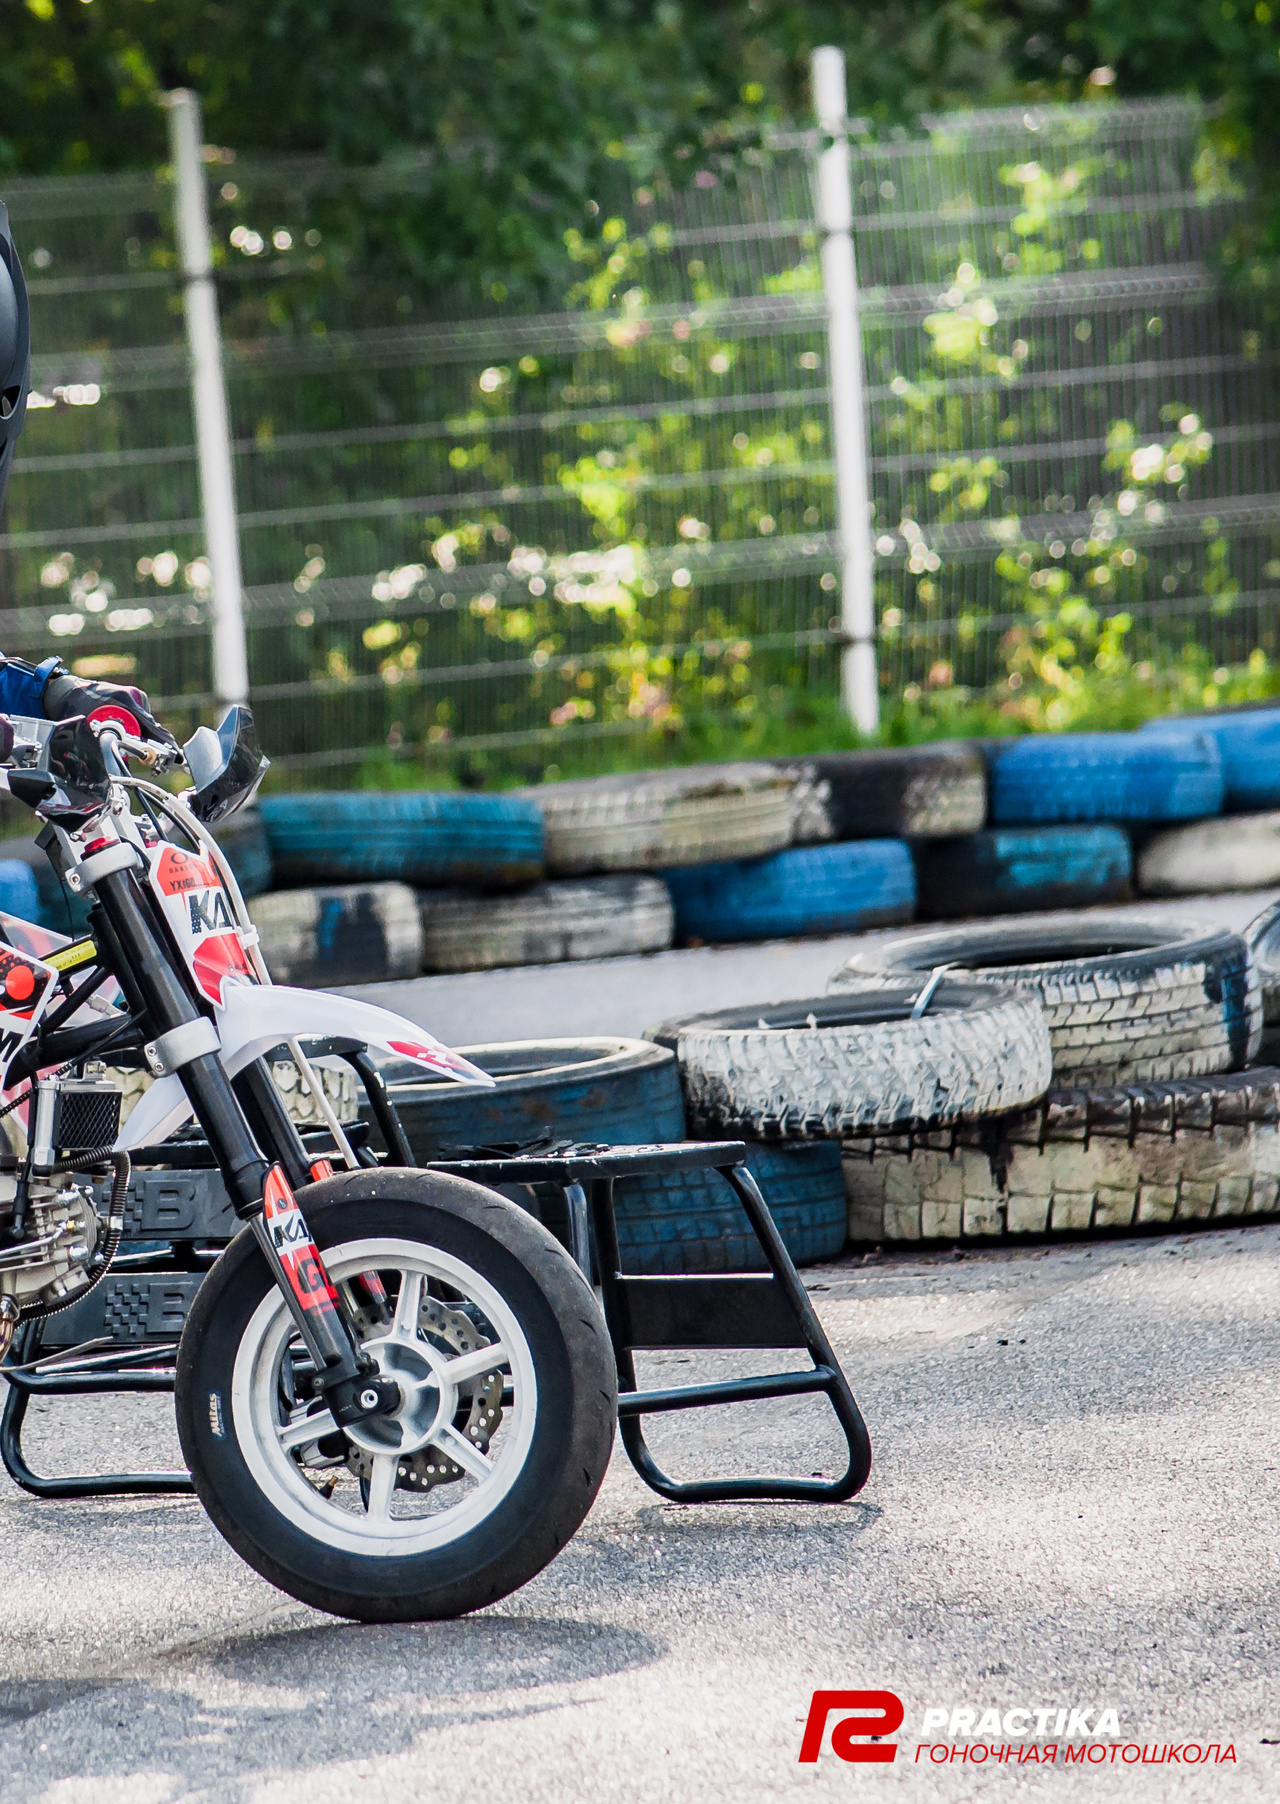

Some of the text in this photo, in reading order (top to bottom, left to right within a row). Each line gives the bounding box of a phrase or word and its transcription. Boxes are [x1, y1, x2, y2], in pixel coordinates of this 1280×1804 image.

[188, 889, 235, 934] KA
[273, 1213, 313, 1249] KA
[296, 1257, 326, 1295] G
[209, 1392, 223, 1437] Mitas
